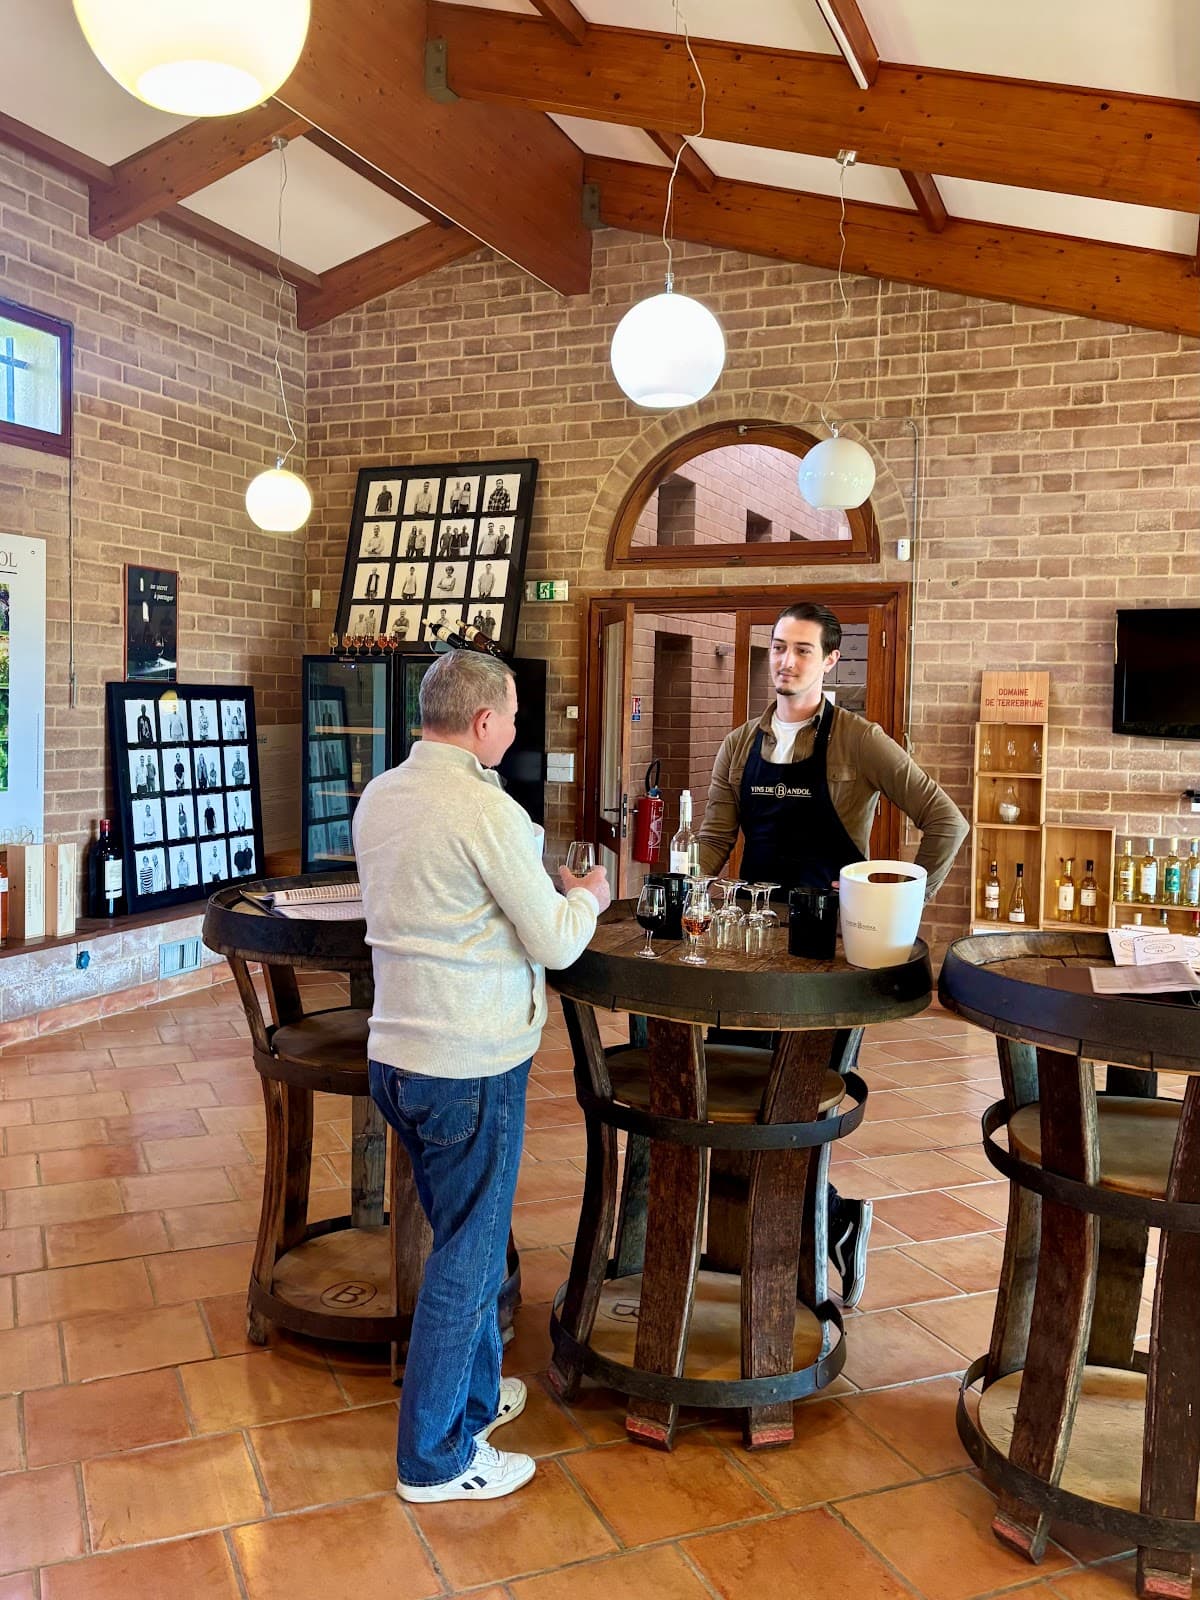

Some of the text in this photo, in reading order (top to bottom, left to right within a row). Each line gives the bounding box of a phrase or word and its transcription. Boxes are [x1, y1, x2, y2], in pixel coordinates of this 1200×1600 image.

[998, 688, 1029, 697] DOMAINE
[985, 698, 1045, 708] DE TERREBRUNE
[331, 1285, 367, 1303] B
